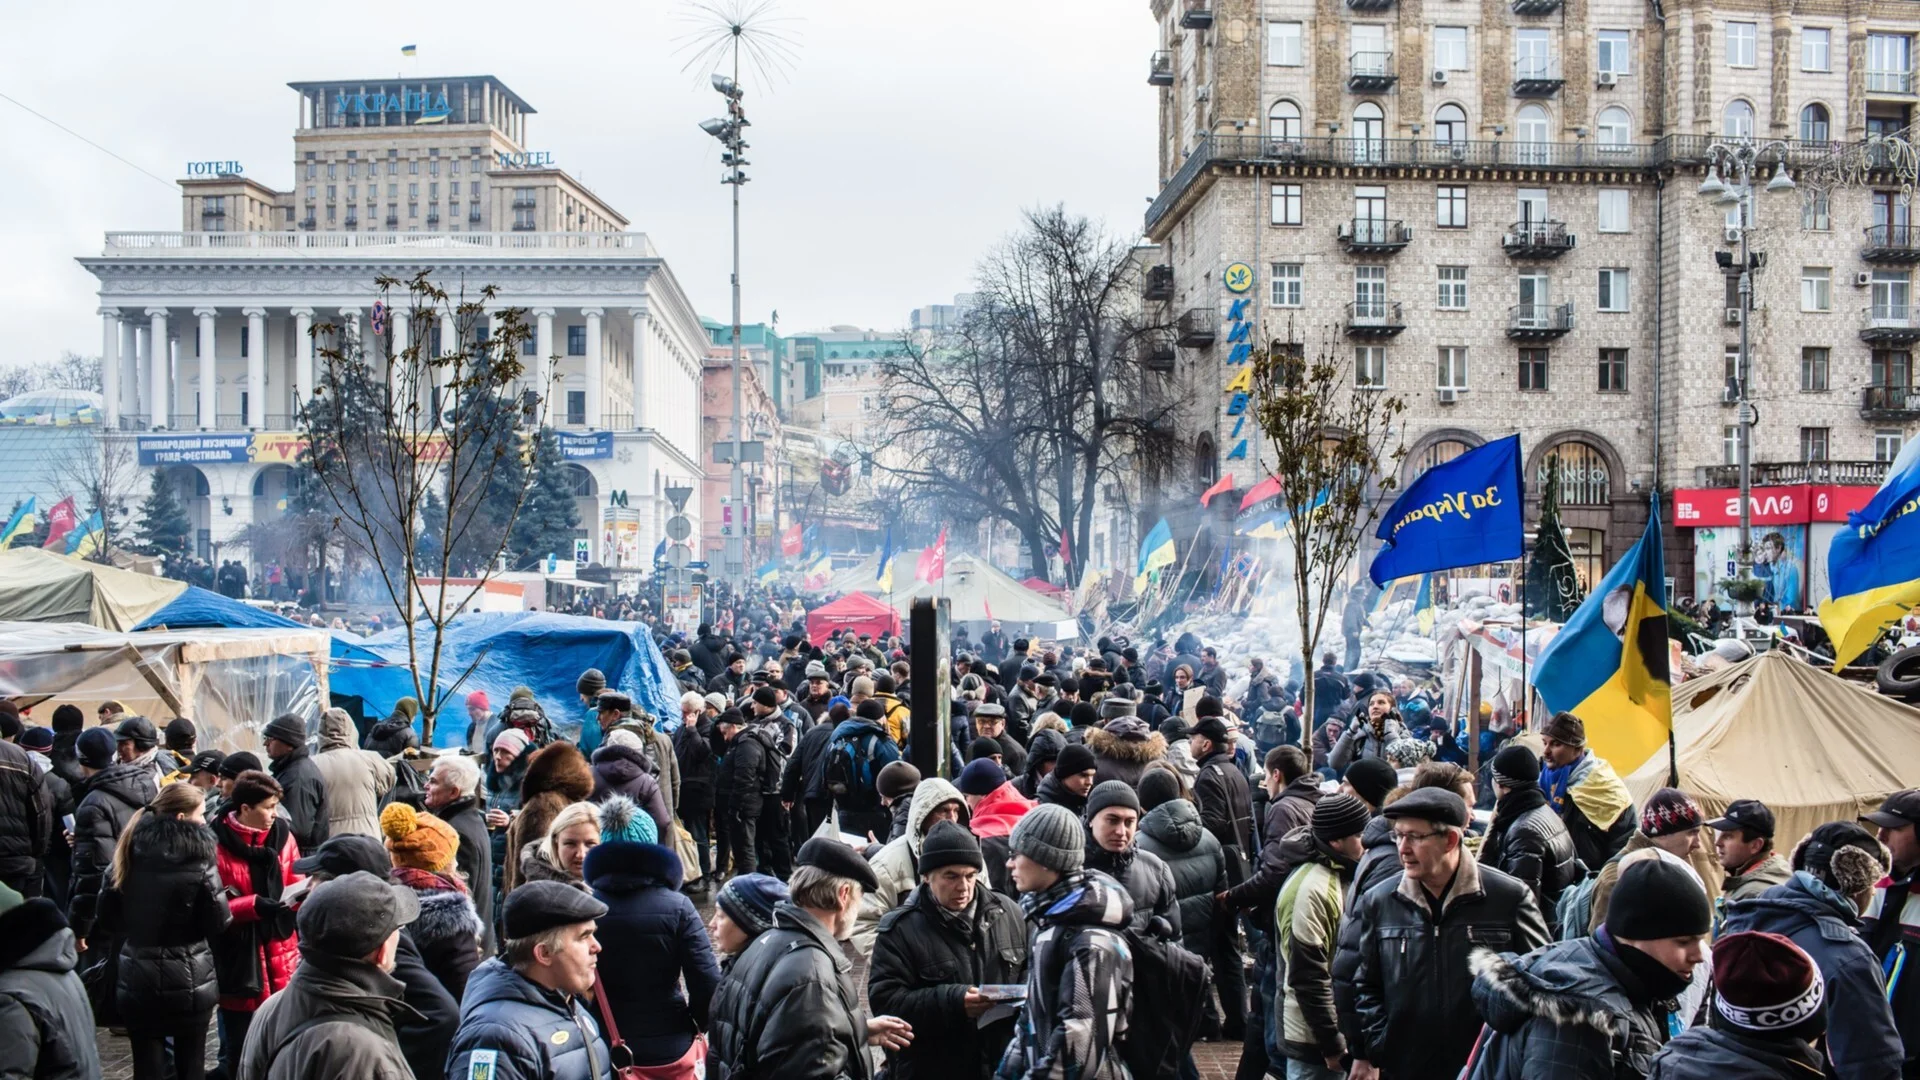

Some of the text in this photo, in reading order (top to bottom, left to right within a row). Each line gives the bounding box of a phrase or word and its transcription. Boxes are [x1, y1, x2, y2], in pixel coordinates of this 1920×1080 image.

[336, 89, 449, 113] УКРАЇНА
[500, 151, 555, 167] HOTEL
[187, 160, 244, 175] ГОТЕЛЬ
[203, 437, 247, 449] МУЗИЧНИЙ
[155, 450, 232, 462] ГРАНД-ФЕСТИВАЛЬ
